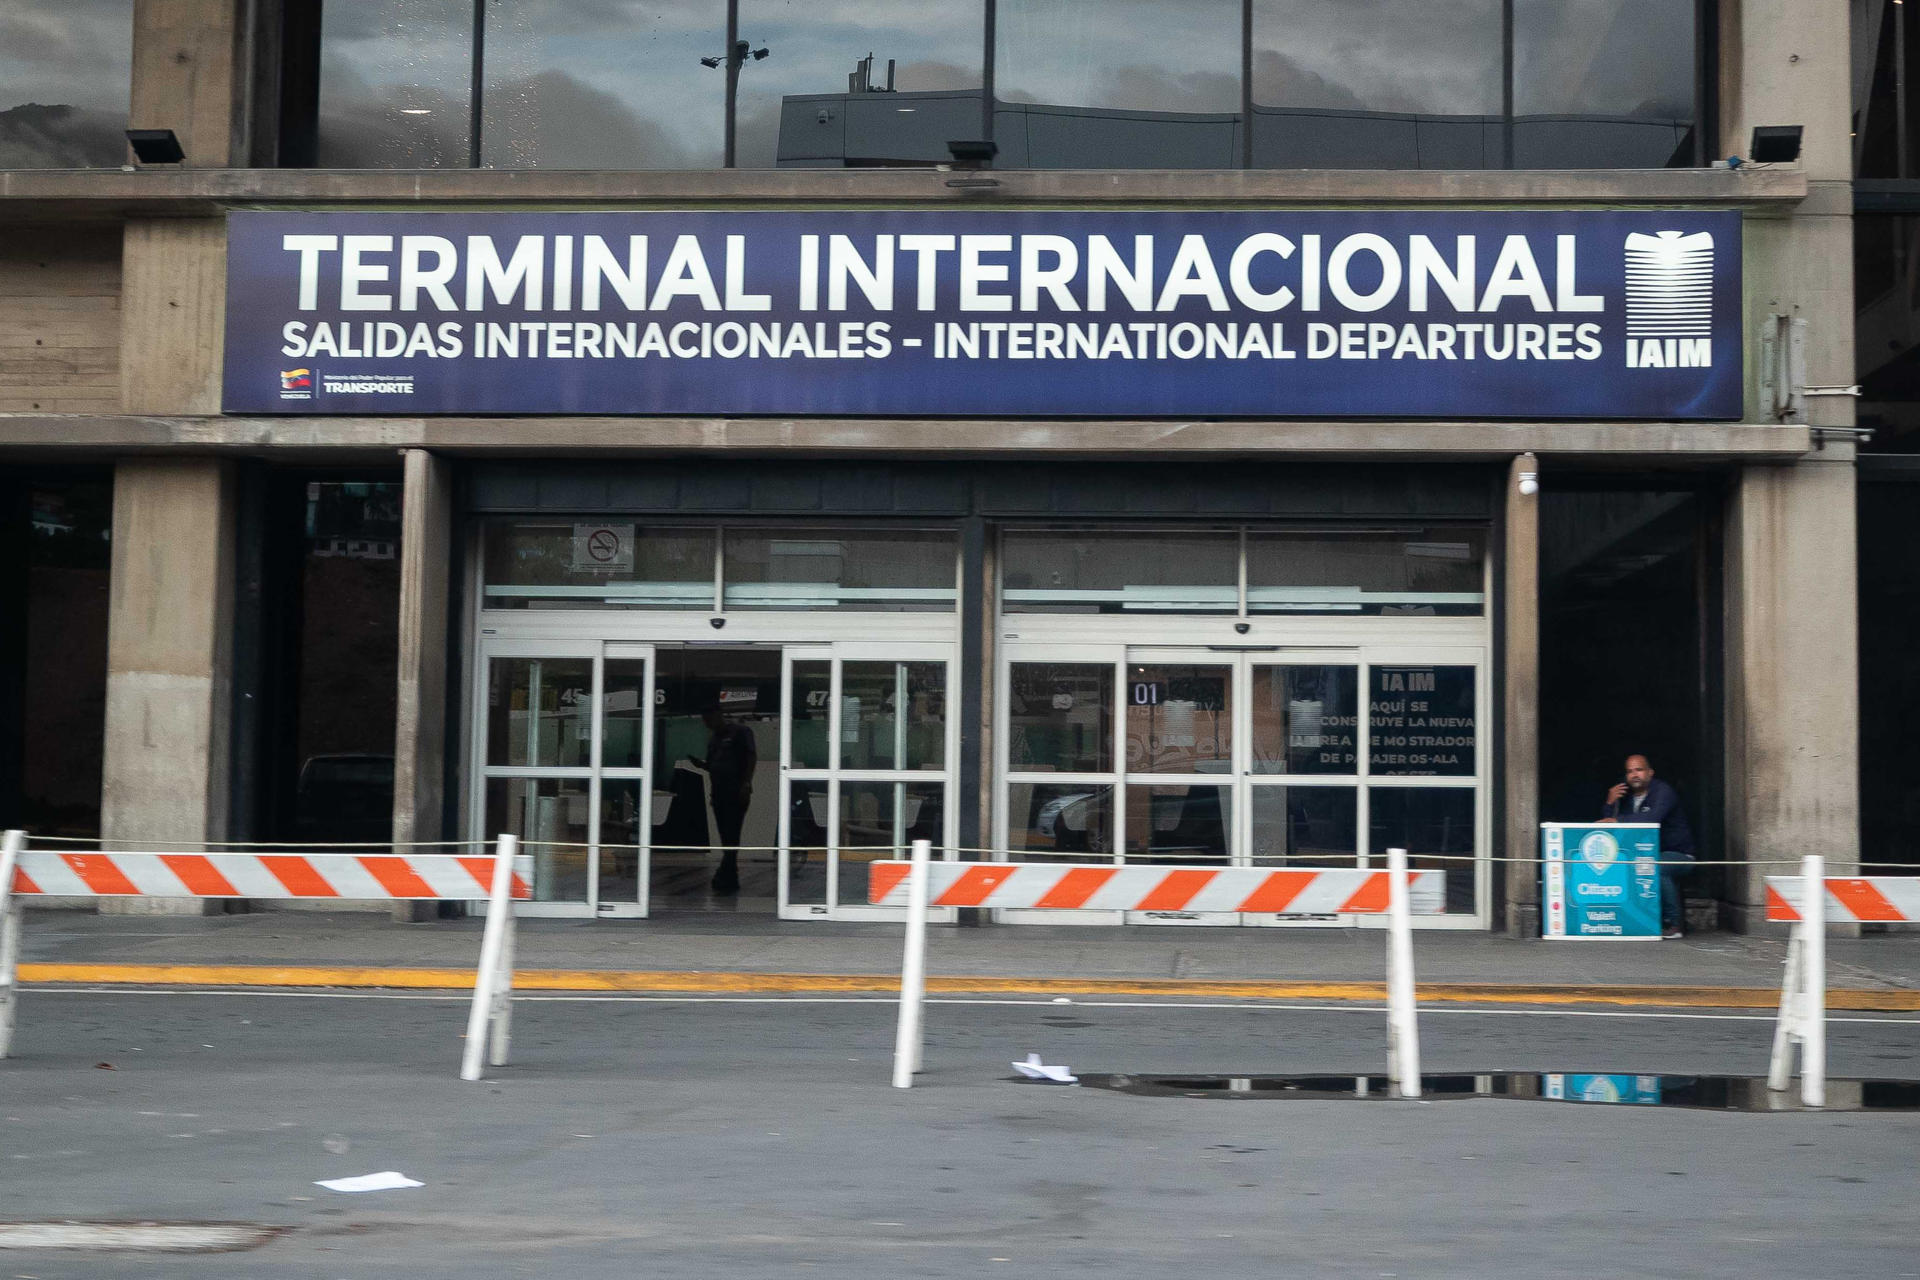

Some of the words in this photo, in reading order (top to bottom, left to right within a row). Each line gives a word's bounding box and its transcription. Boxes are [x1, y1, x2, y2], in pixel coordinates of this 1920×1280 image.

[283, 235, 772, 312] TERMINAL
[800, 232, 1605, 313] INTERNACIONAL
[282, 321, 463, 359] SALIDAS
[475, 321, 892, 360] INTERNACIONALES
[935, 322, 1297, 361] INTERNATIONAL
[1308, 322, 1603, 361] DEPARTURES
[1625, 338, 1712, 369] IAIM
[323, 382, 414, 394] TRANSPORTE
[806, 690, 829, 707] 47
[1135, 683, 1157, 705] 01
[1410, 701, 1429, 713] SE
[1320, 716, 1404, 728] CONSRUYE
[1408, 717, 1426, 728] LA
[1429, 717, 1474, 728] NUEVA
[1320, 752, 1340, 764] DE
[1580, 923, 1623, 935] Parking
